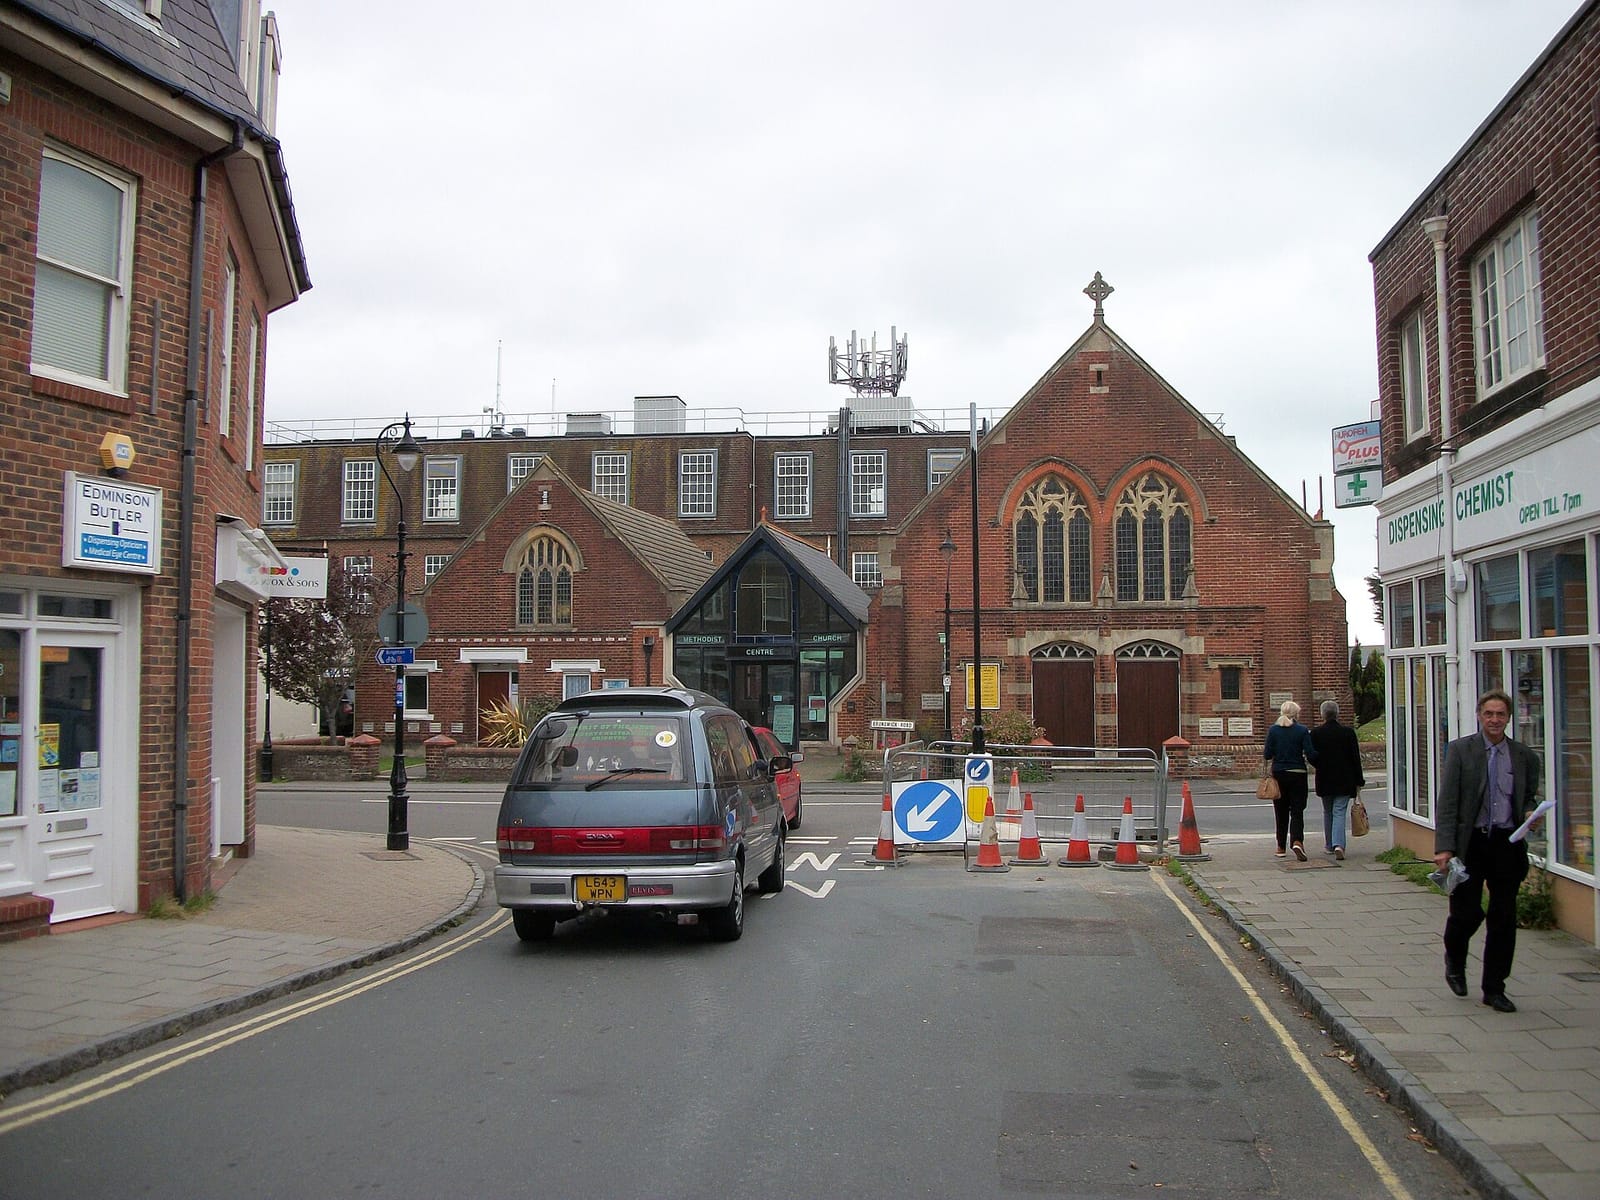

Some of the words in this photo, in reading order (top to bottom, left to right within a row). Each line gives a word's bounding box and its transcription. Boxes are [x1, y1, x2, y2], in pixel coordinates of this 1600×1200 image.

[1348, 446, 1380, 460] PLUS
[82, 484, 150, 508] EDMINSON
[90, 503, 142, 524] BUTLER
[1388, 500, 1444, 545] DISPENSING
[1455, 471, 1514, 521] CHEMIST
[1519, 502, 1540, 525] OPEN
[1543, 498, 1559, 515] TILL
[1562, 492, 1582, 514] 7pm
[87, 535, 119, 548] Dispensing
[120, 540, 143, 549] Optician
[88, 546, 111, 556] Medical
[112, 549, 123, 559] Eye
[123, 551, 142, 560] Centre
[287, 577, 294, 587] &
[296, 579, 319, 588] sons
[683, 635, 722, 643] METHODIST
[46, 823, 52, 833] 2
[585, 877, 616, 888] L643
[590, 888, 613, 898] WPN
[632, 886, 656, 894] ELVIS
